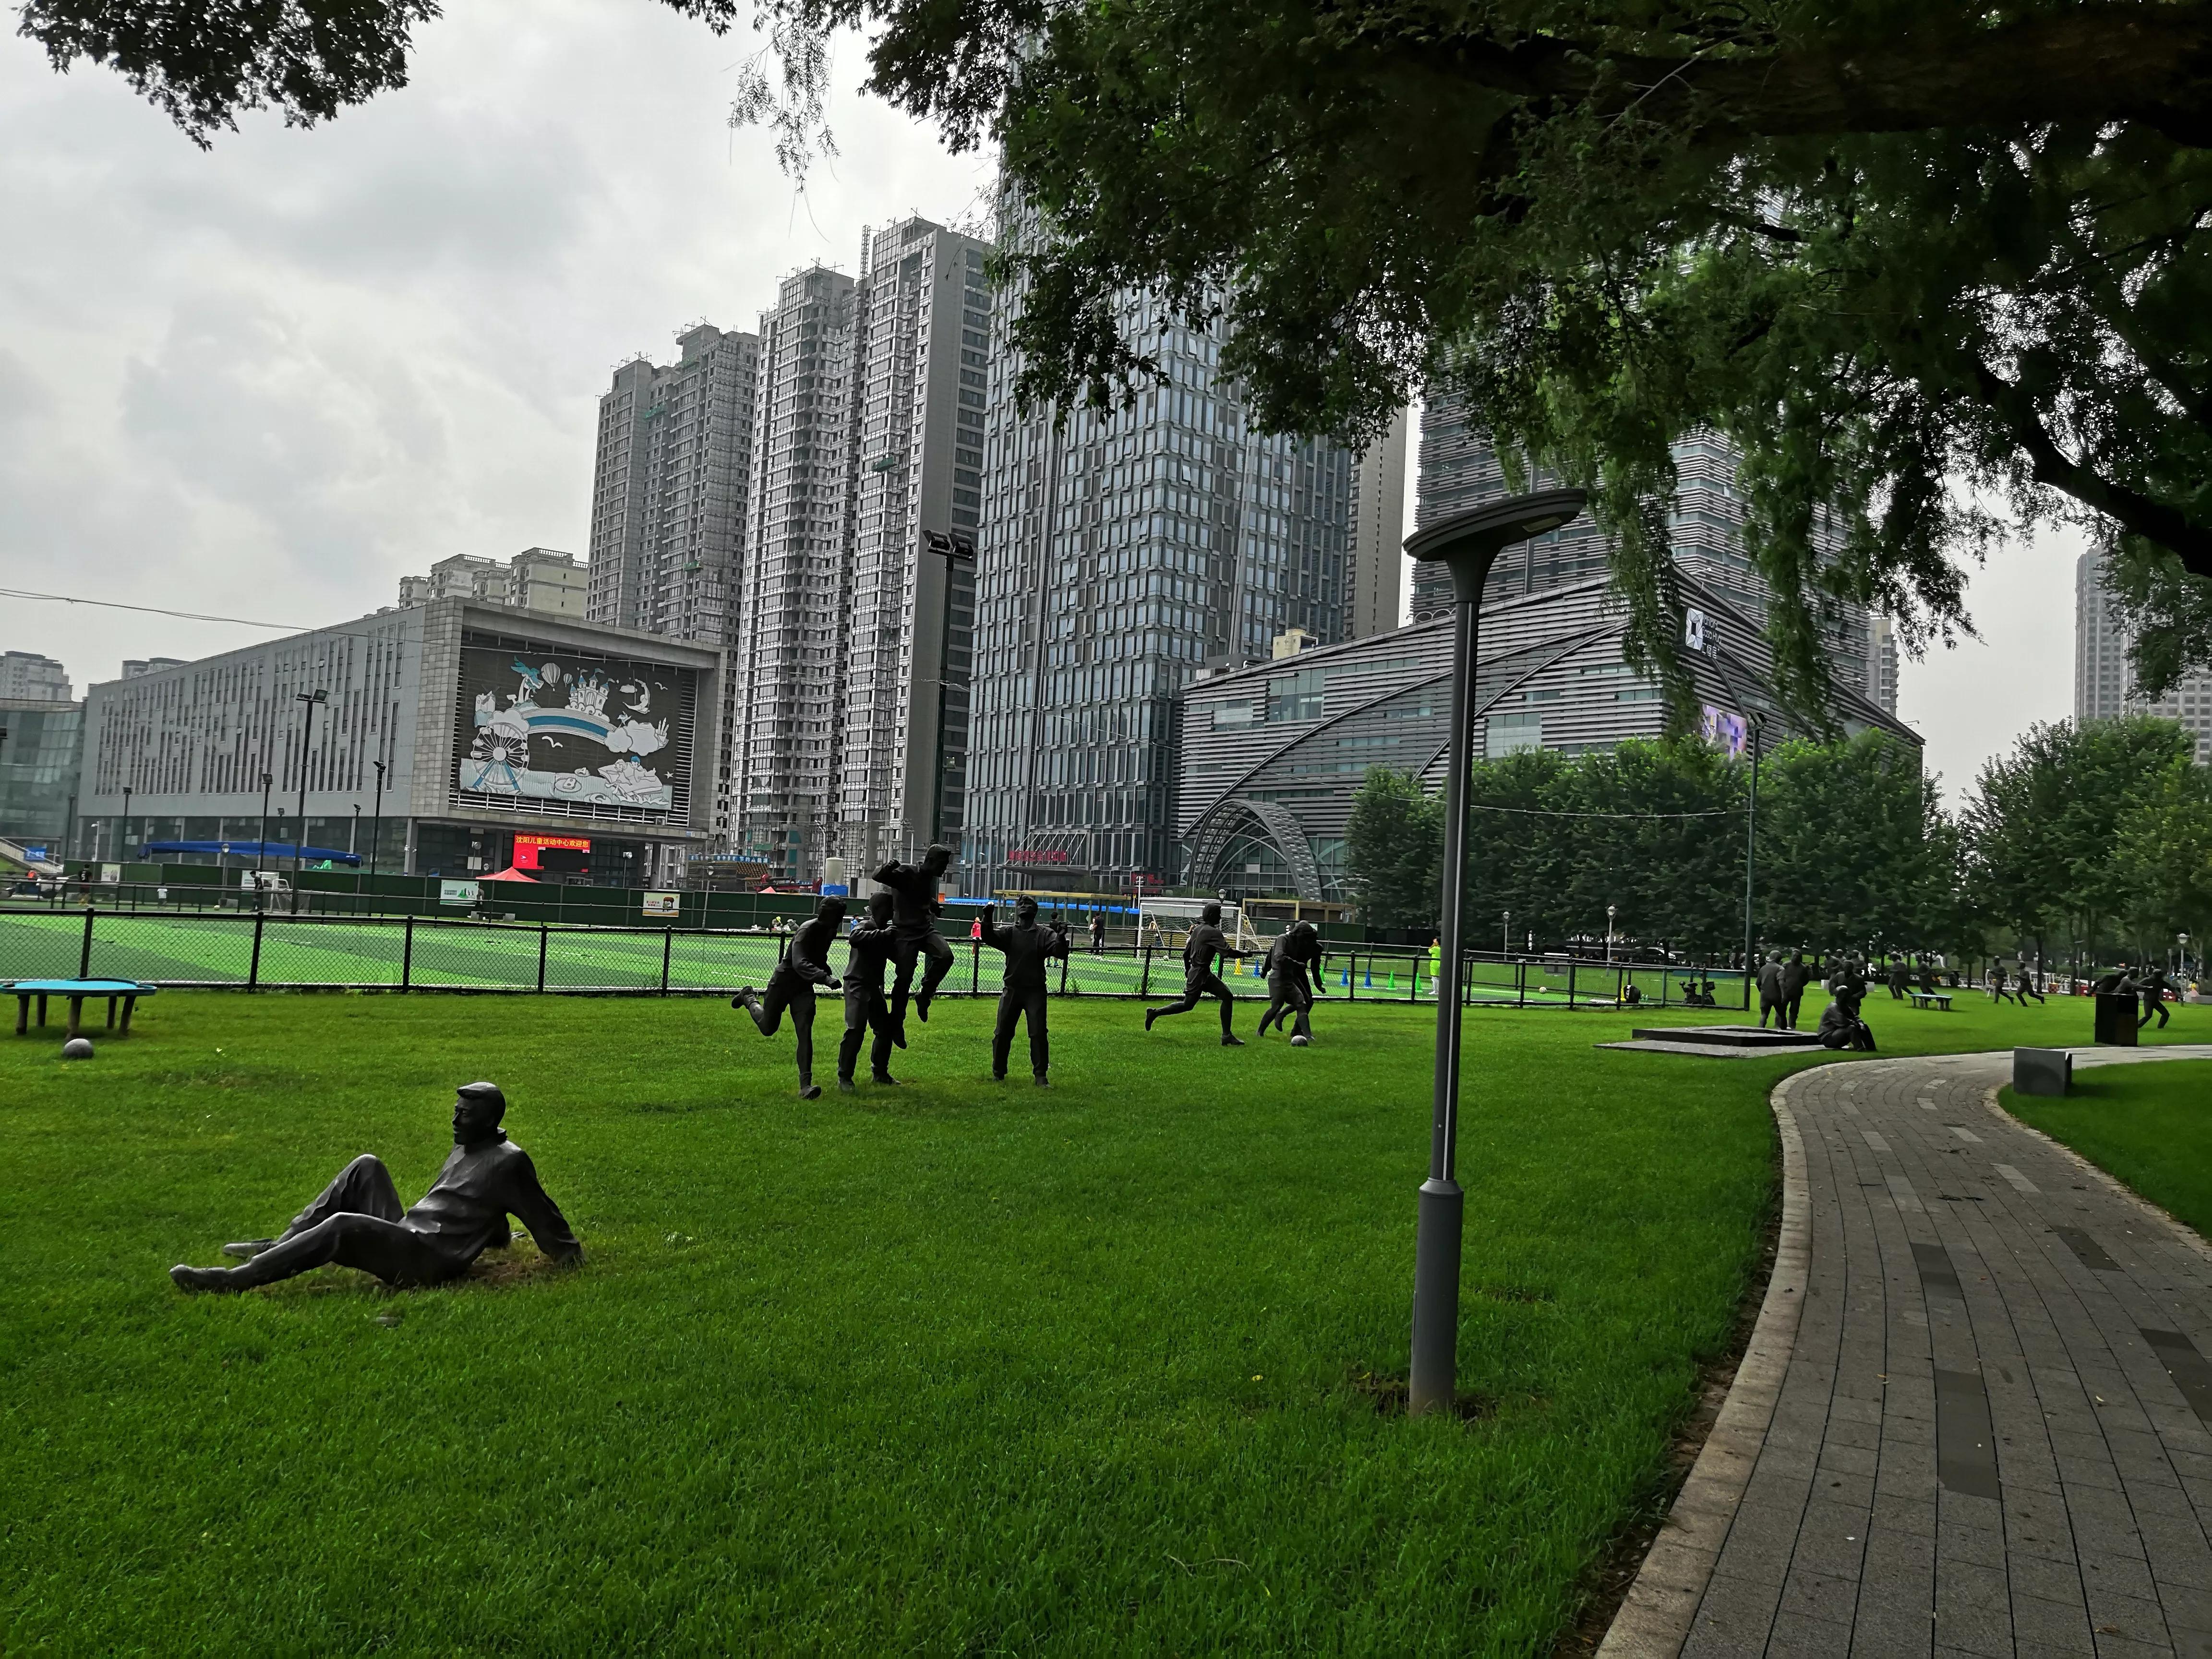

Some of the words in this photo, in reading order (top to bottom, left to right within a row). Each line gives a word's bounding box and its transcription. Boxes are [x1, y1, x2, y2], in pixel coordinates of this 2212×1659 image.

[516, 836, 589, 848] 沈阳儿童活动中心欢迎您
